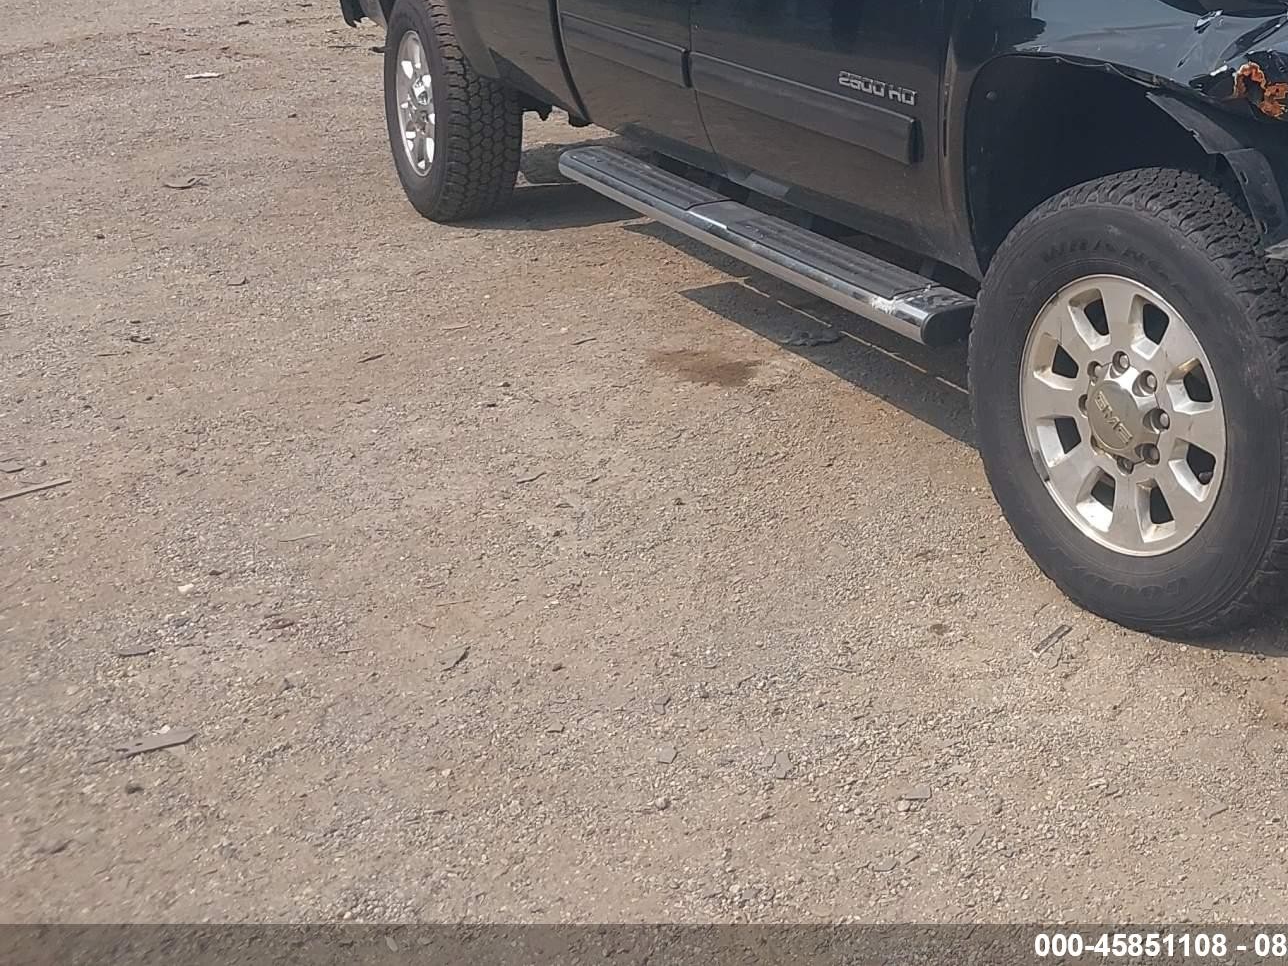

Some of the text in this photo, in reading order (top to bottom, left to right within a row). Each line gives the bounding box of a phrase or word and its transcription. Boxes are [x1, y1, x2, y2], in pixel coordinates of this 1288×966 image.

[838, 70, 917, 106] 2500 HD
[1094, 391, 1133, 442] GMC
